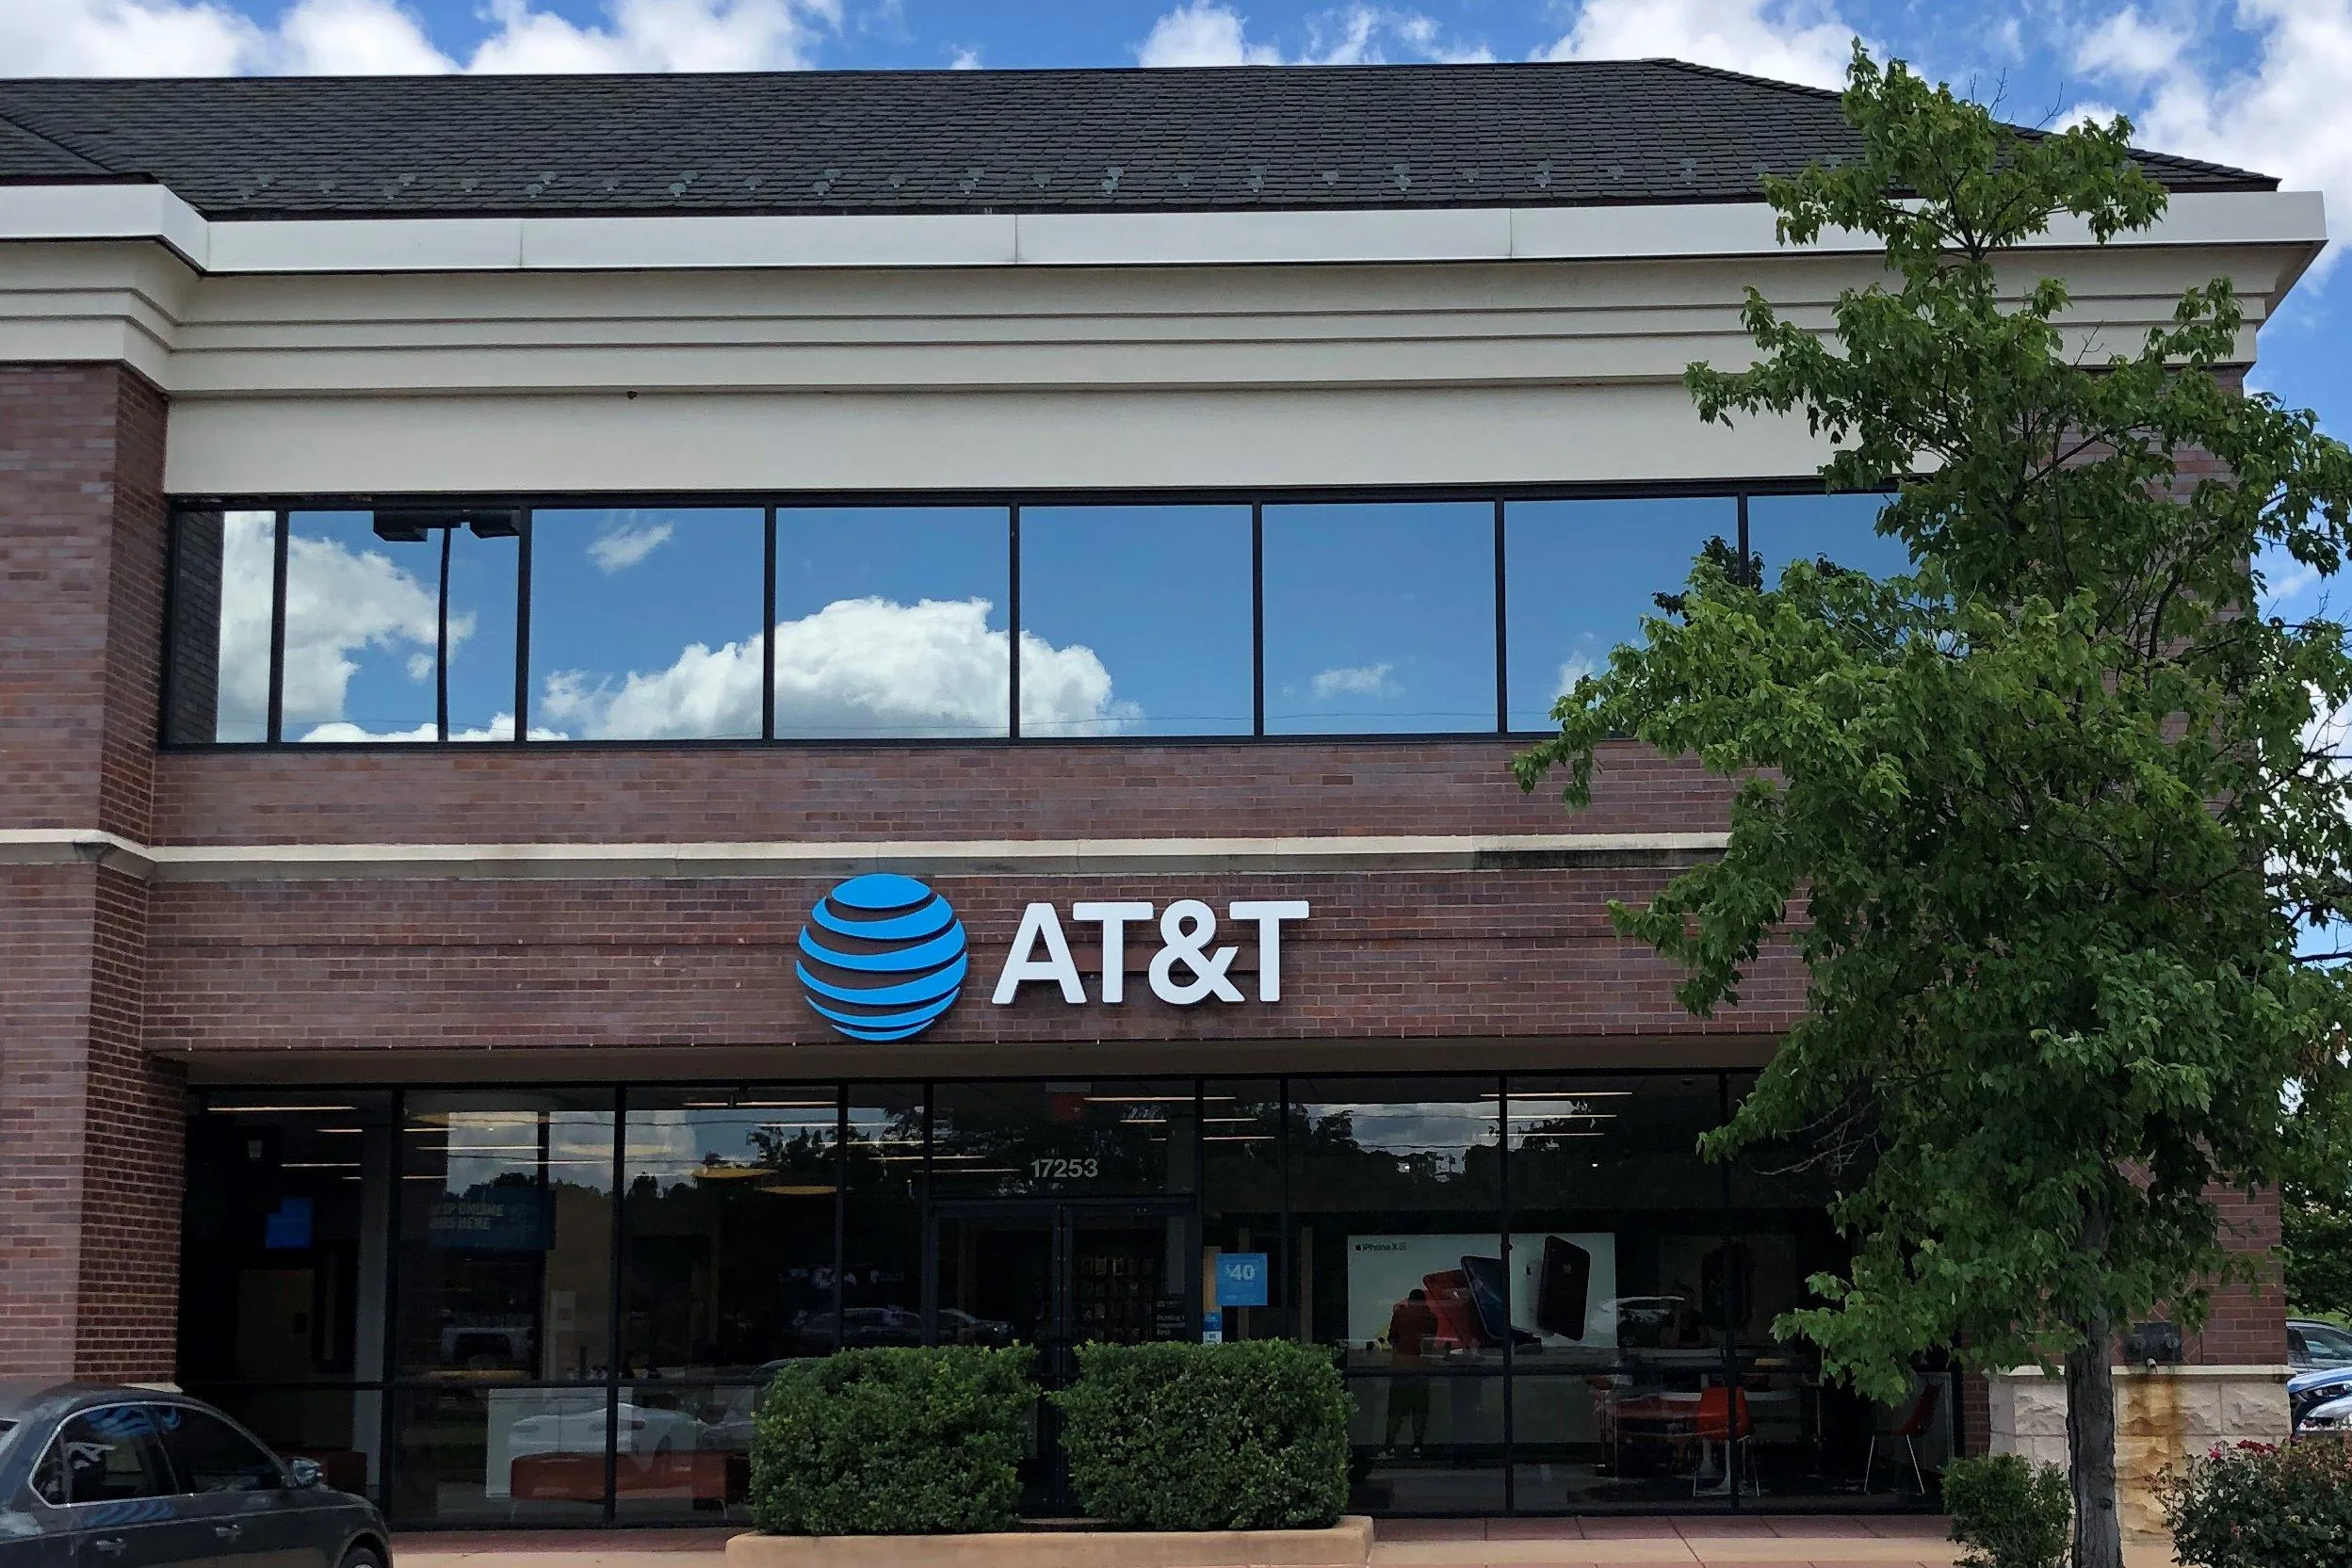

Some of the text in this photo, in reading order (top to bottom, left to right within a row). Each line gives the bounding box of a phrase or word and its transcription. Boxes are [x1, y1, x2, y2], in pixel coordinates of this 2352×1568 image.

[991, 898, 1310, 1006] AT&T
[1030, 1157, 1098, 1178] 17253
[1362, 1242, 1391, 1252] iPhone
